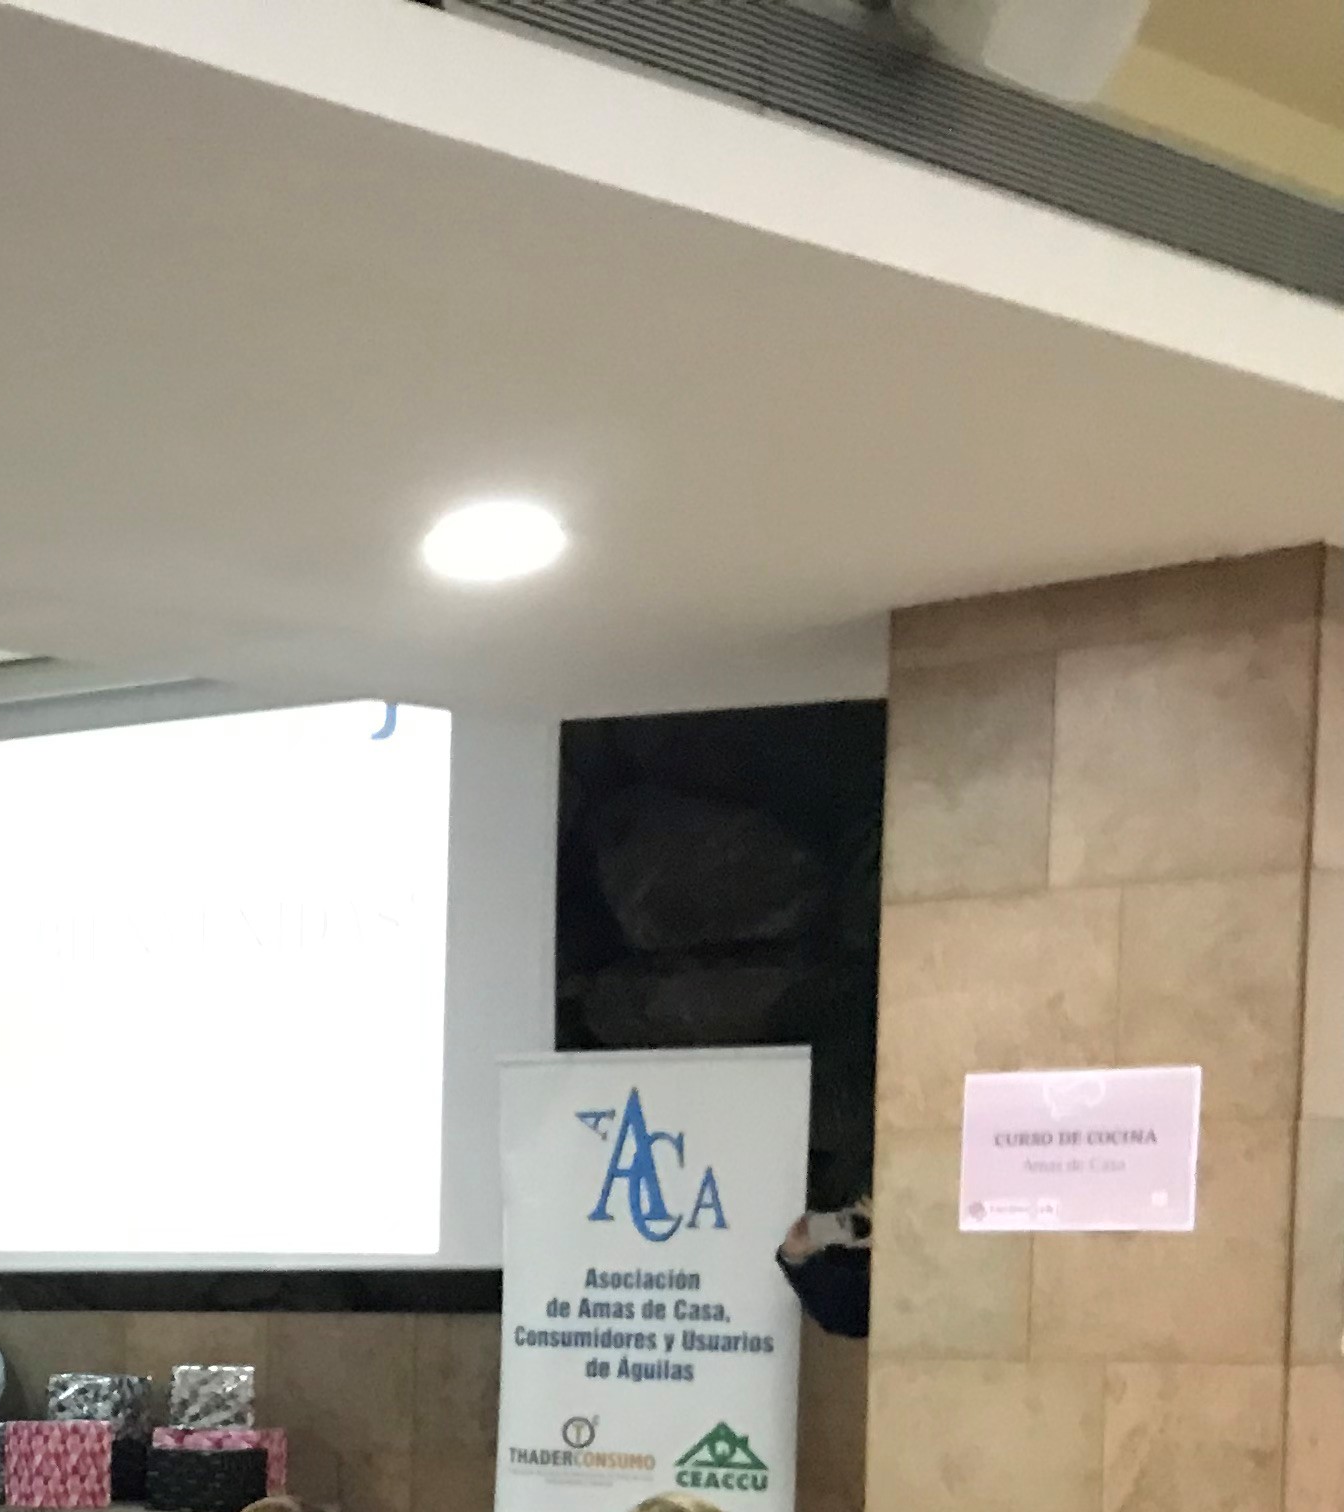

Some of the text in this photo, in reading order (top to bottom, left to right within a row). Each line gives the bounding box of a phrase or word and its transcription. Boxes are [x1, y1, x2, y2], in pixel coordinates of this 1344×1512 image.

[993, 1128, 1158, 1147] CURSO DE COCINA
[584, 1267, 700, 1290] Asociación
[545, 1298, 731, 1323] de Amas de Casa,
[514, 1325, 774, 1353] Consumidores y Usuarios
[585, 1355, 694, 1382] de Águilas
[674, 1470, 769, 1492] CEACCU
